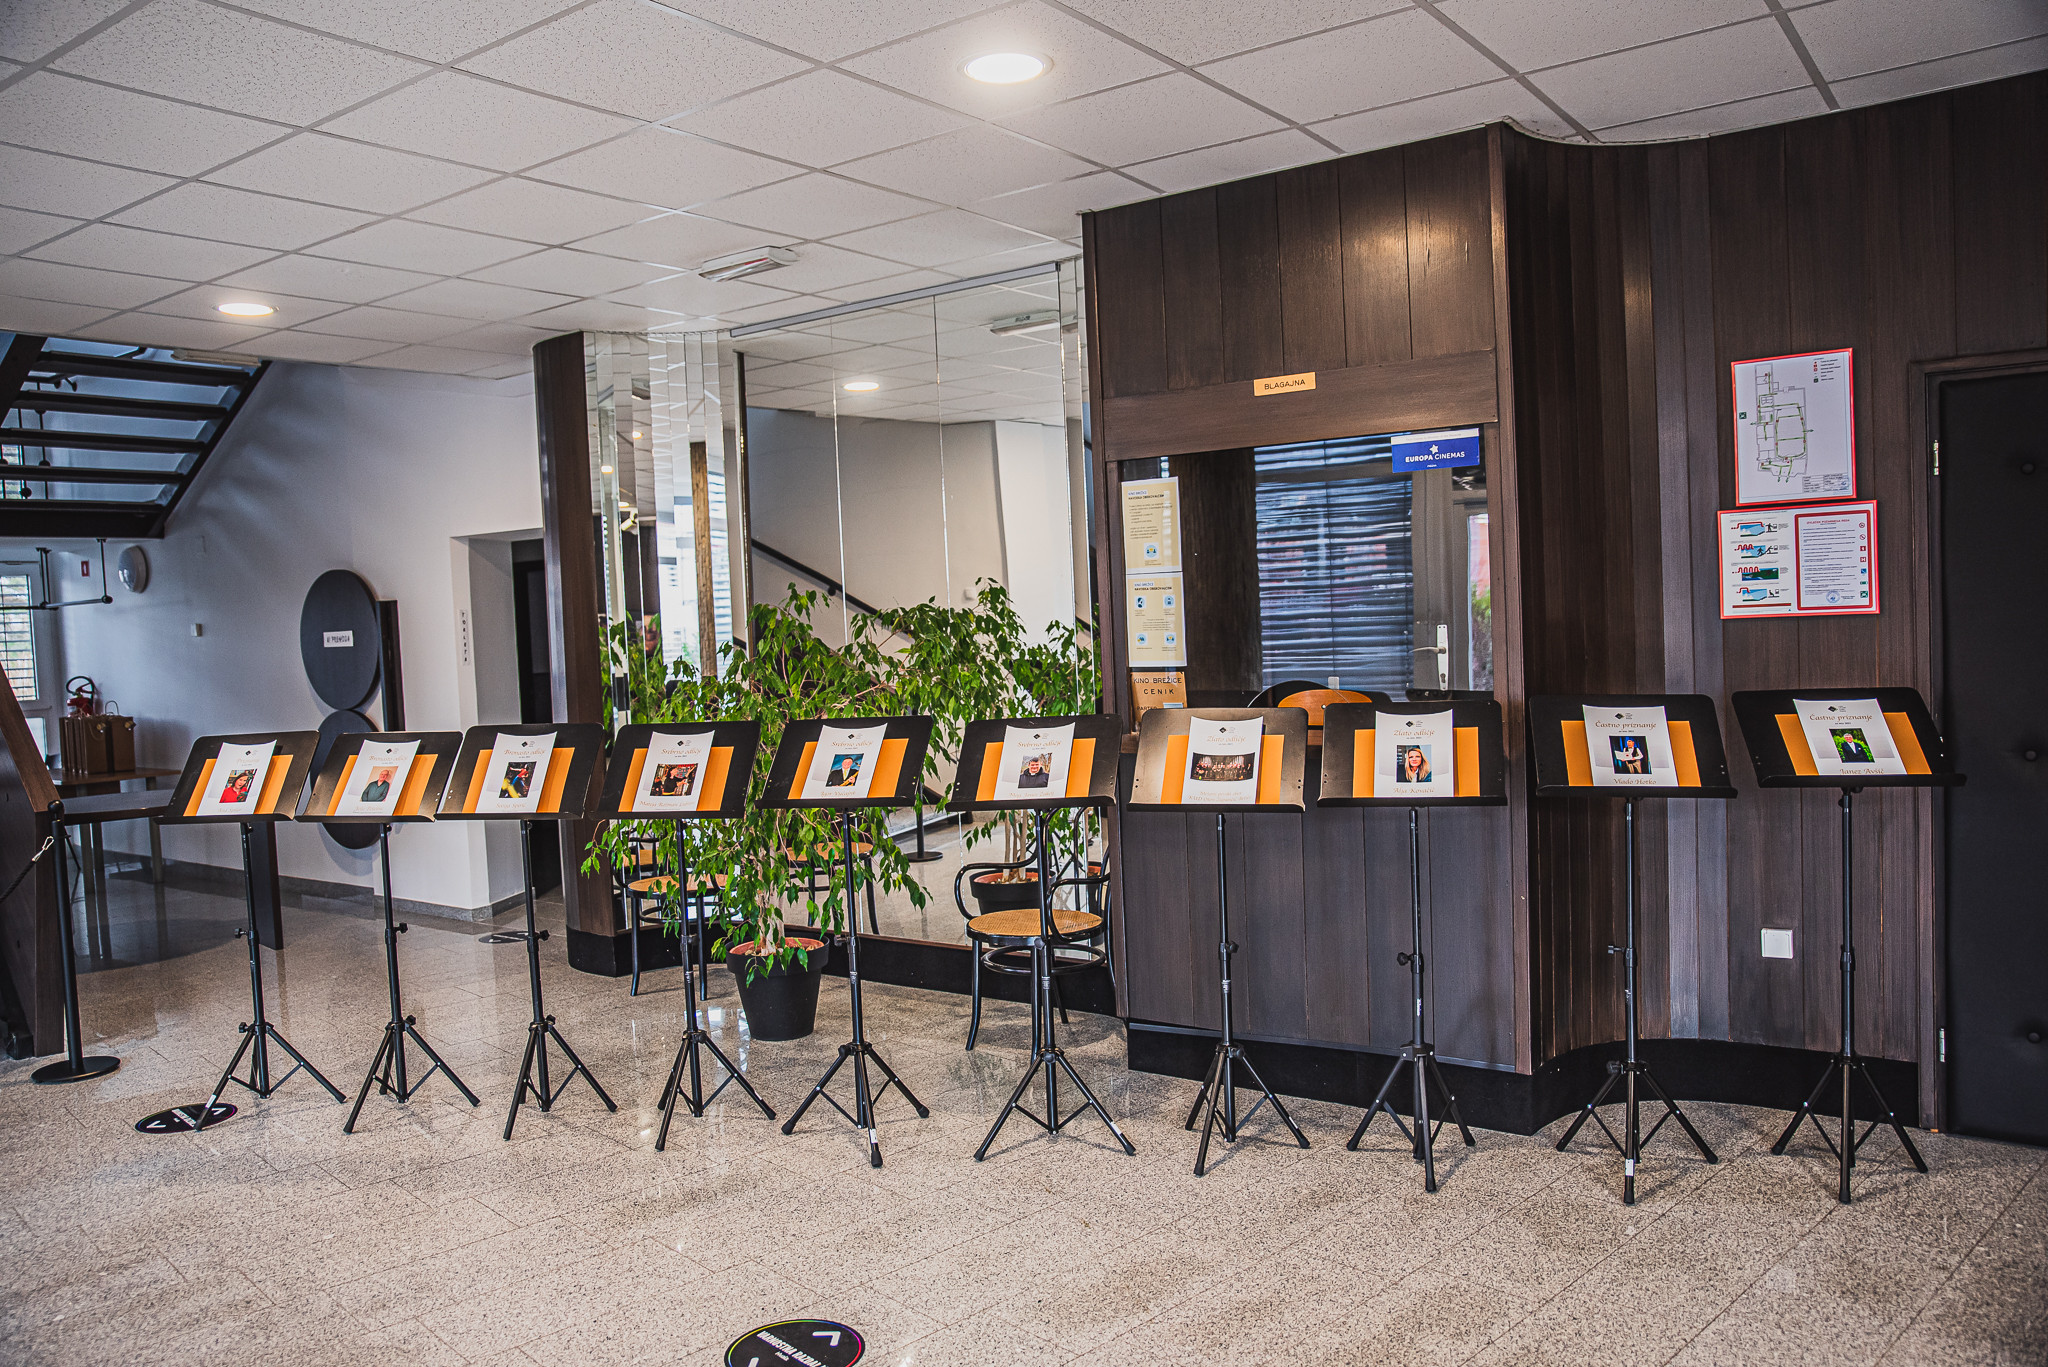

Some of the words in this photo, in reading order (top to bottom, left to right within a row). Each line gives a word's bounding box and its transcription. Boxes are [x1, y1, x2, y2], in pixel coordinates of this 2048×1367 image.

[1264, 379, 1306, 390] BLAGAJNA
[1405, 454, 1433, 463] EUROPA
[1434, 451, 1466, 460] CINEMAS
[1152, 675, 1183, 684] BREŽICE
[1809, 713, 1835, 721] Častno
[1837, 714, 1873, 723] priznanje
[1595, 720, 1621, 729] Častno
[1621, 721, 1657, 730] priznanje
[757, 1330, 797, 1356] VARNOSTNA
